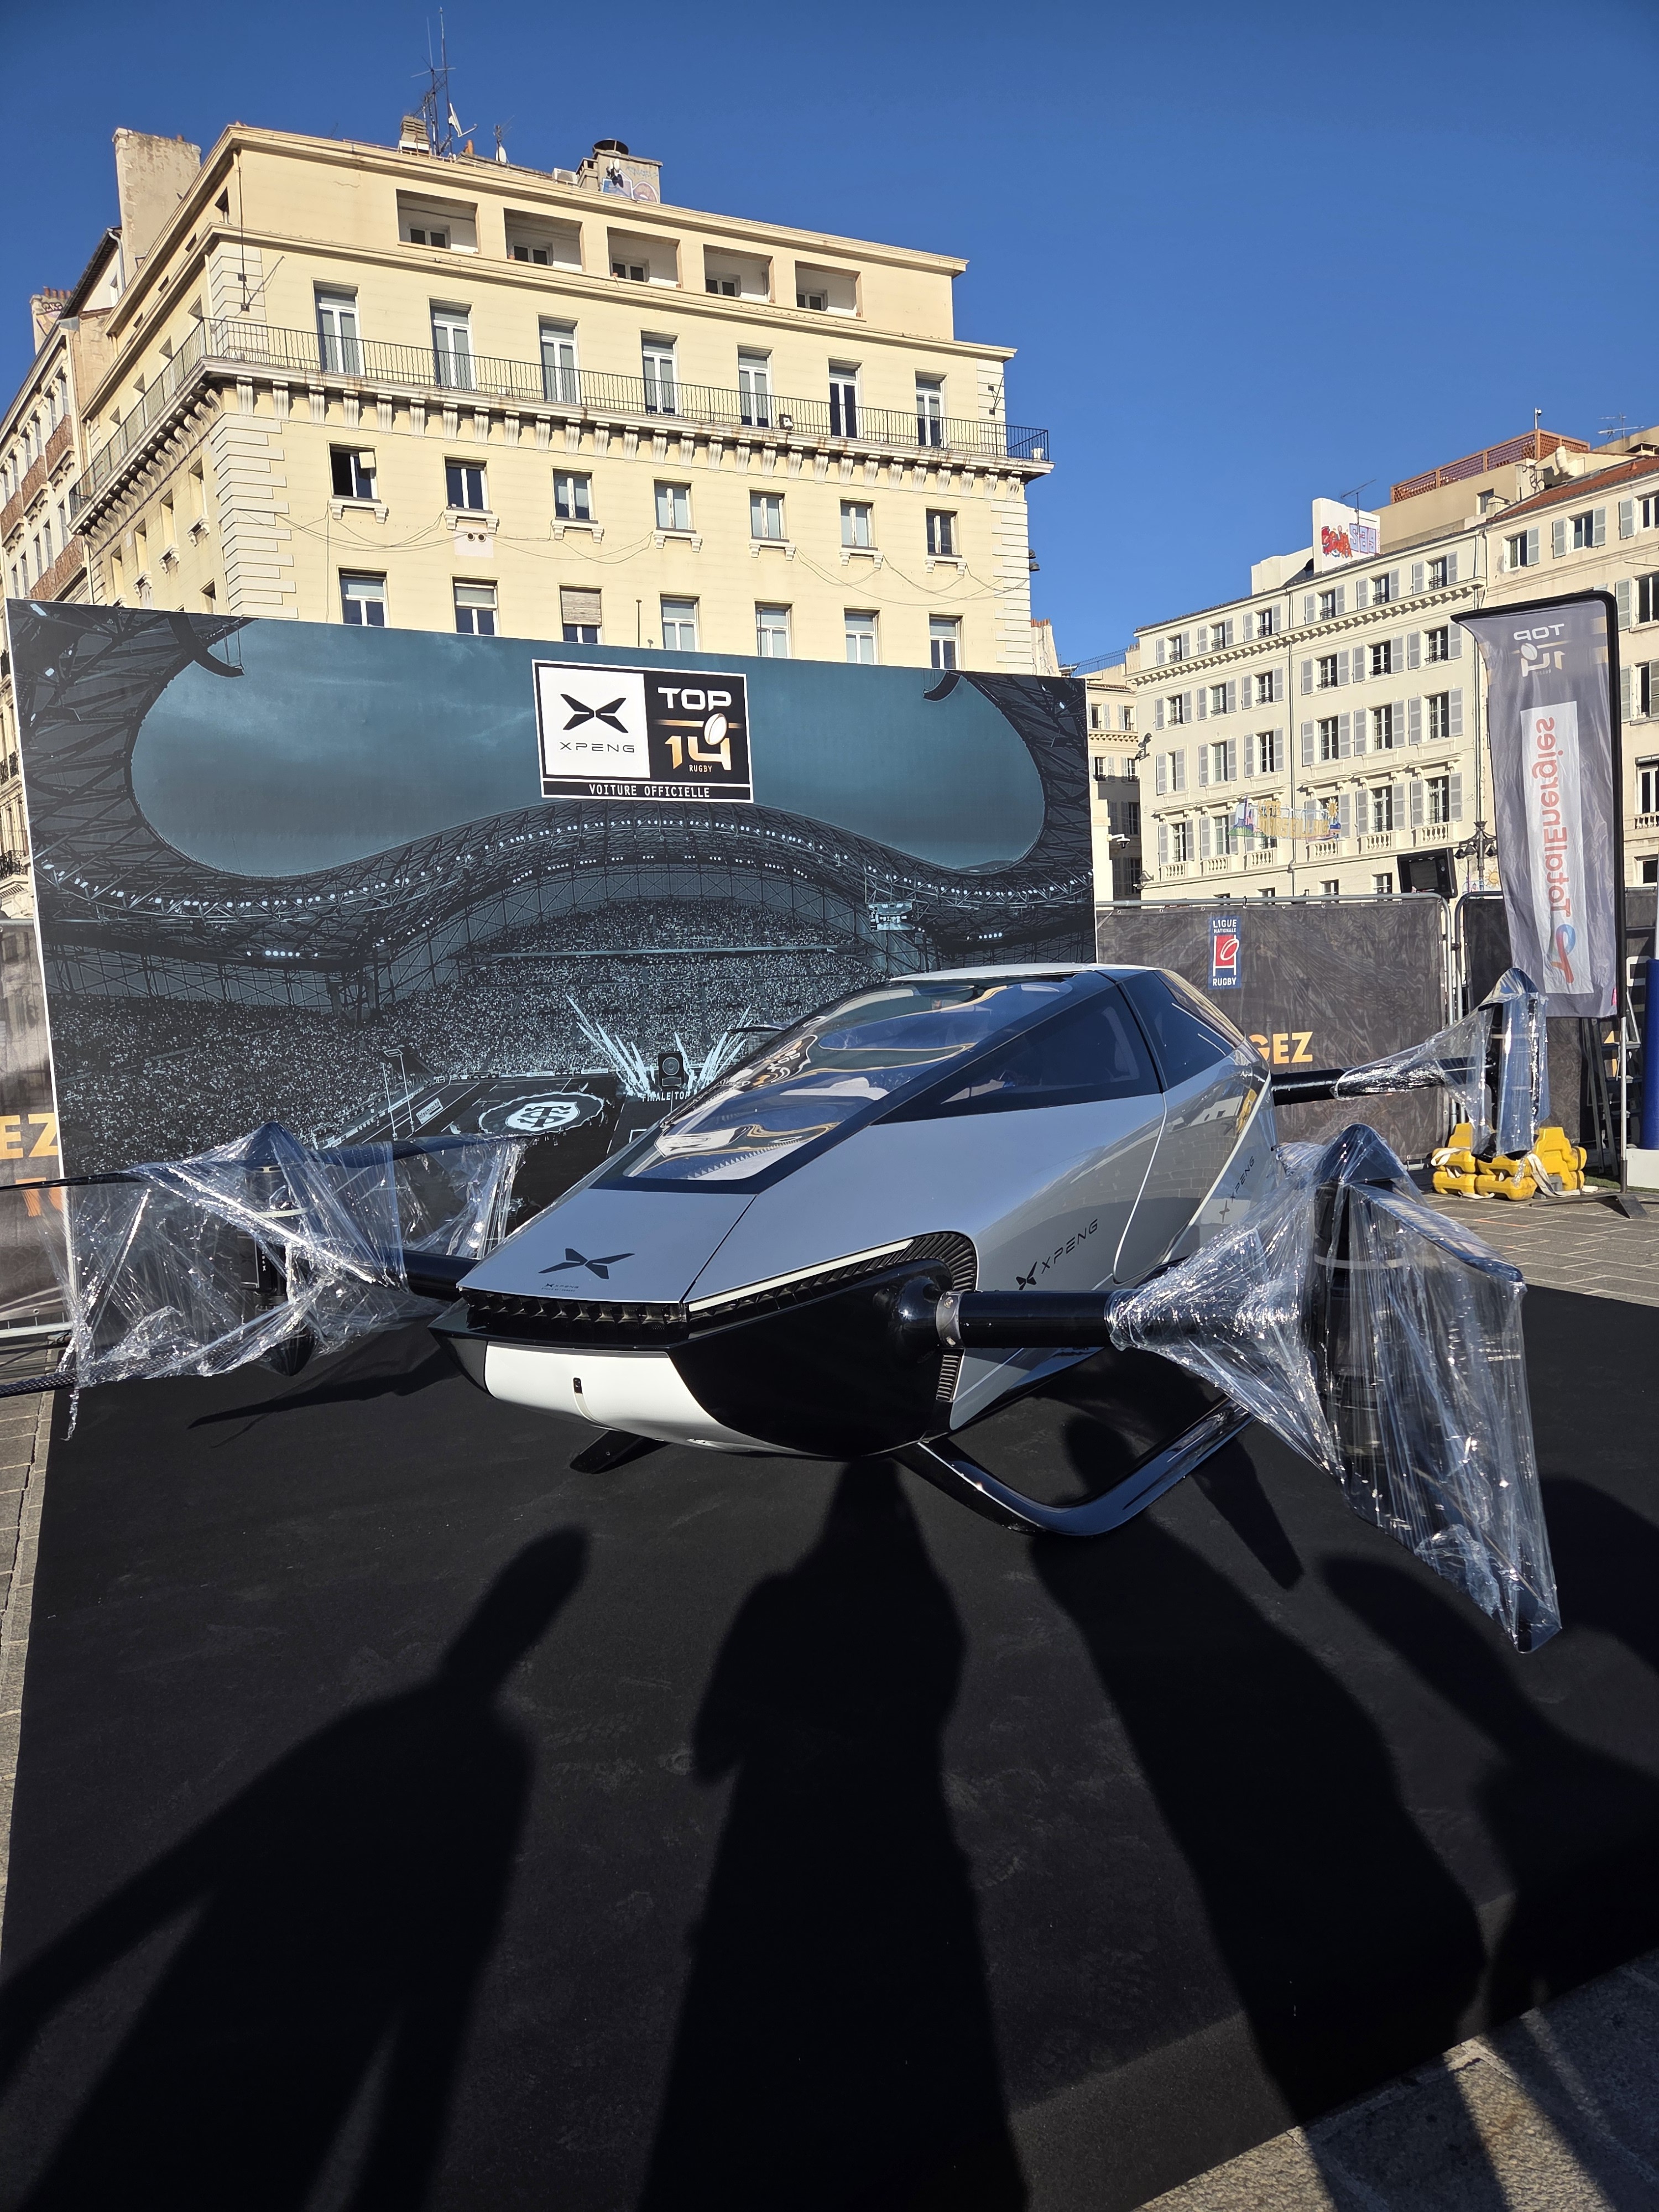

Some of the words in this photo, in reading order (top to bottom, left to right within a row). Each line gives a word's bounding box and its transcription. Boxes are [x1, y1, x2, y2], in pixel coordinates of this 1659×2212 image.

[658, 687, 732, 711] TOP
[560, 742, 635, 753] XPENG
[665, 735, 732, 770] 14
[689, 764, 712, 773] RUGBY
[589, 784, 637, 796] VOITURE
[644, 786, 710, 797] OFFICIELLE
[1213, 919, 1237, 928] LIGUE
[1212, 977, 1237, 986] RUGBY
[1230, 1156, 1254, 1203] XPENG
[1041, 1218, 1098, 1274] XPENG
